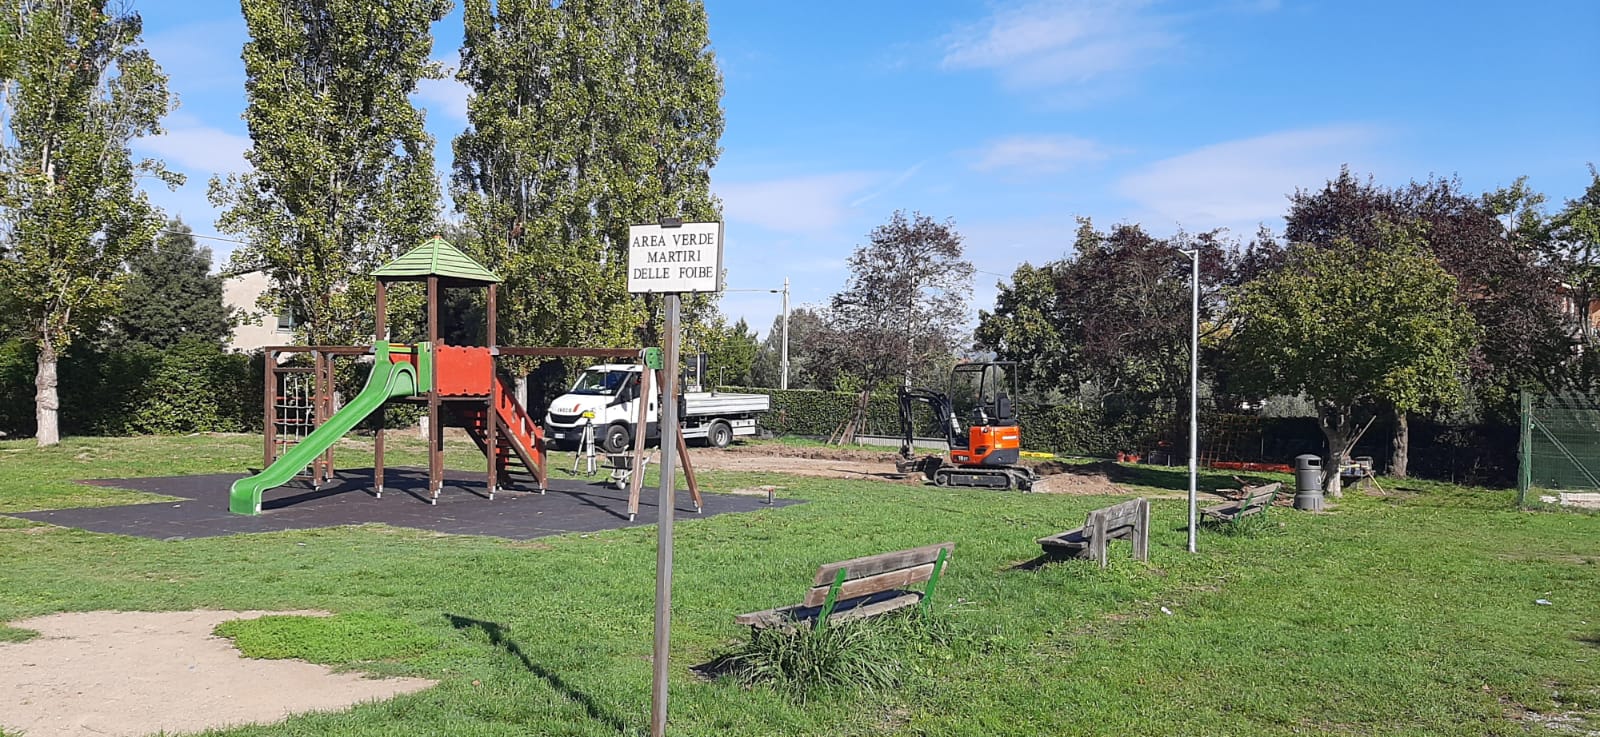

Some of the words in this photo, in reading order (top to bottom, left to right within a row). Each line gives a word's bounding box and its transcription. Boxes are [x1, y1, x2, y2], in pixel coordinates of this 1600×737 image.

[632, 235, 666, 247] AREA
[672, 233, 714, 246] VERDE
[647, 250, 701, 263] MARTIRI
[633, 268, 670, 279] DELLE
[679, 266, 713, 278] FOIBE
